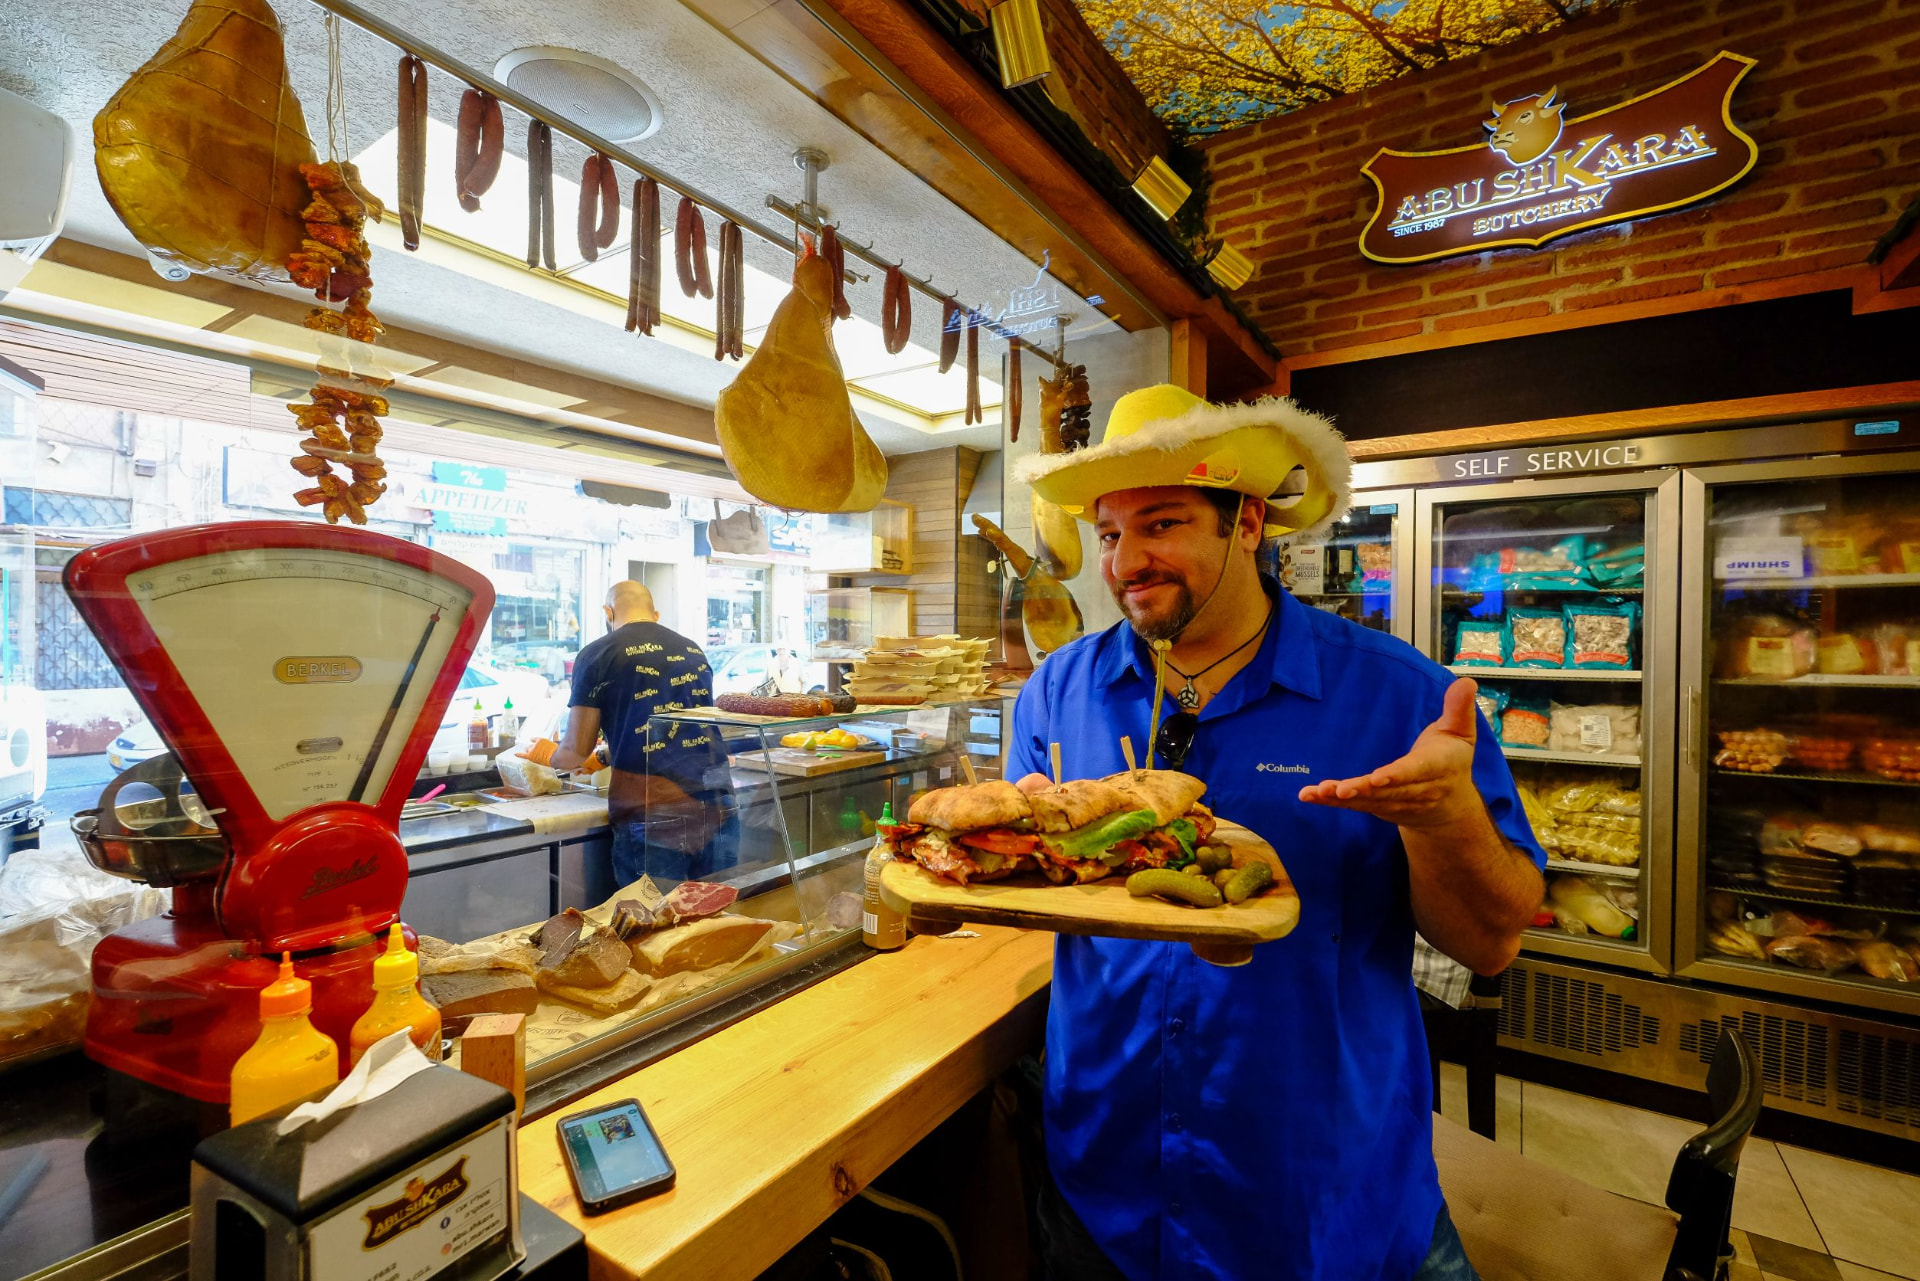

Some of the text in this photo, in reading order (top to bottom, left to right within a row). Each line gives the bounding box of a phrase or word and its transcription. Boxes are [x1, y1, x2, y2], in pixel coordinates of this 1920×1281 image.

[1391, 125, 1710, 226] ABU SHKARA
[1473, 187, 1612, 236] BUTCHERY
[1393, 218, 1446, 238] SINCE 1987
[1454, 445, 1638, 478] SELF SERVICE
[413, 487, 528, 515] APPETIZER
[1726, 560, 1790, 569] SHRIMP
[286, 662, 351, 677] BERKEL
[1266, 763, 1310, 775] Columbia
